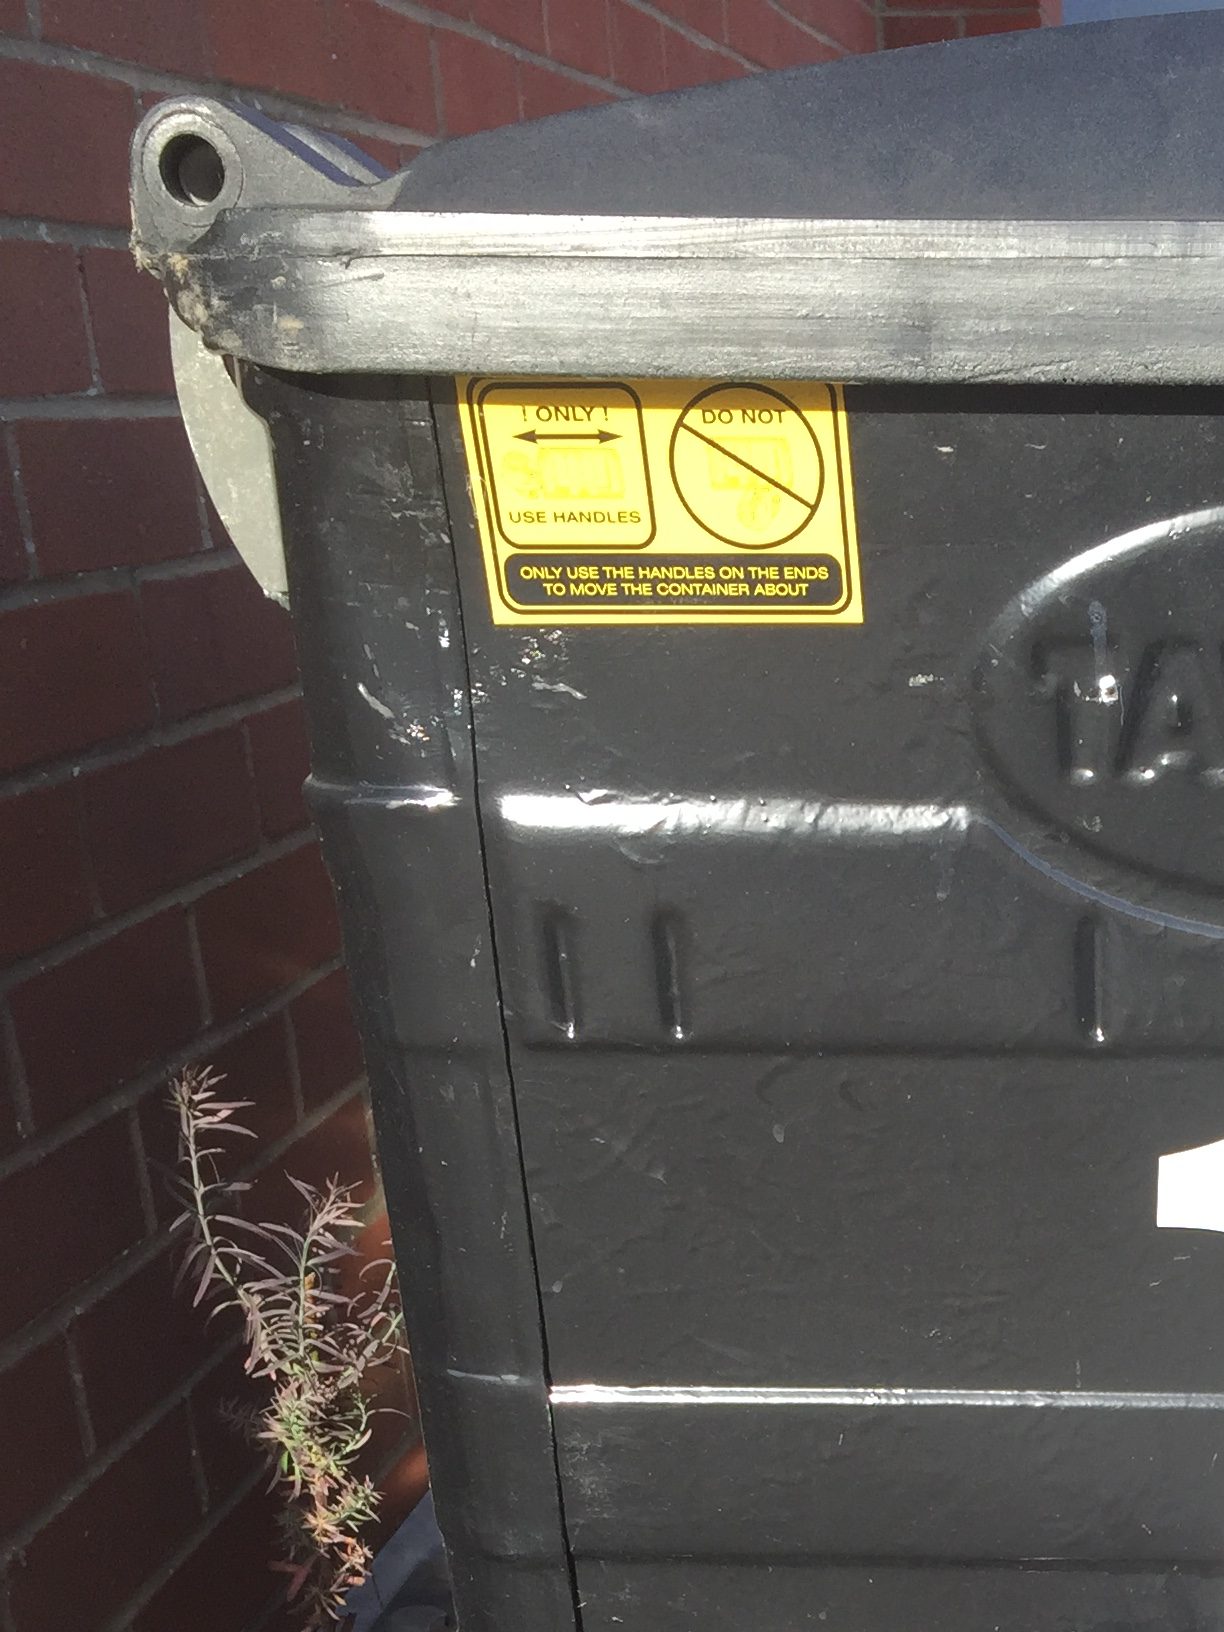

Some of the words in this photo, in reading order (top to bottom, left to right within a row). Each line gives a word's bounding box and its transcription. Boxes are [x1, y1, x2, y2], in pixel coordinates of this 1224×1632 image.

[535, 405, 595, 422] ONLY
[702, 409, 733, 424] DO
[742, 409, 786, 424] NOT
[509, 511, 547, 523] USE
[554, 511, 641, 523] HANDLES
[520, 566, 562, 579] ONLY
[567, 566, 599, 579] USE
[602, 566, 634, 579] THE
[638, 566, 715, 579] HANDLES
[719, 566, 745, 579] ON
[748, 566, 780, 579] THE
[783, 566, 829, 579] ENDS
[543, 583, 566, 596] TO
[570, 583, 618, 596] MOVE
[621, 583, 653, 596] THE
[656, 583, 750, 596] CONTAINER
[754, 583, 809, 596] ABOUT
